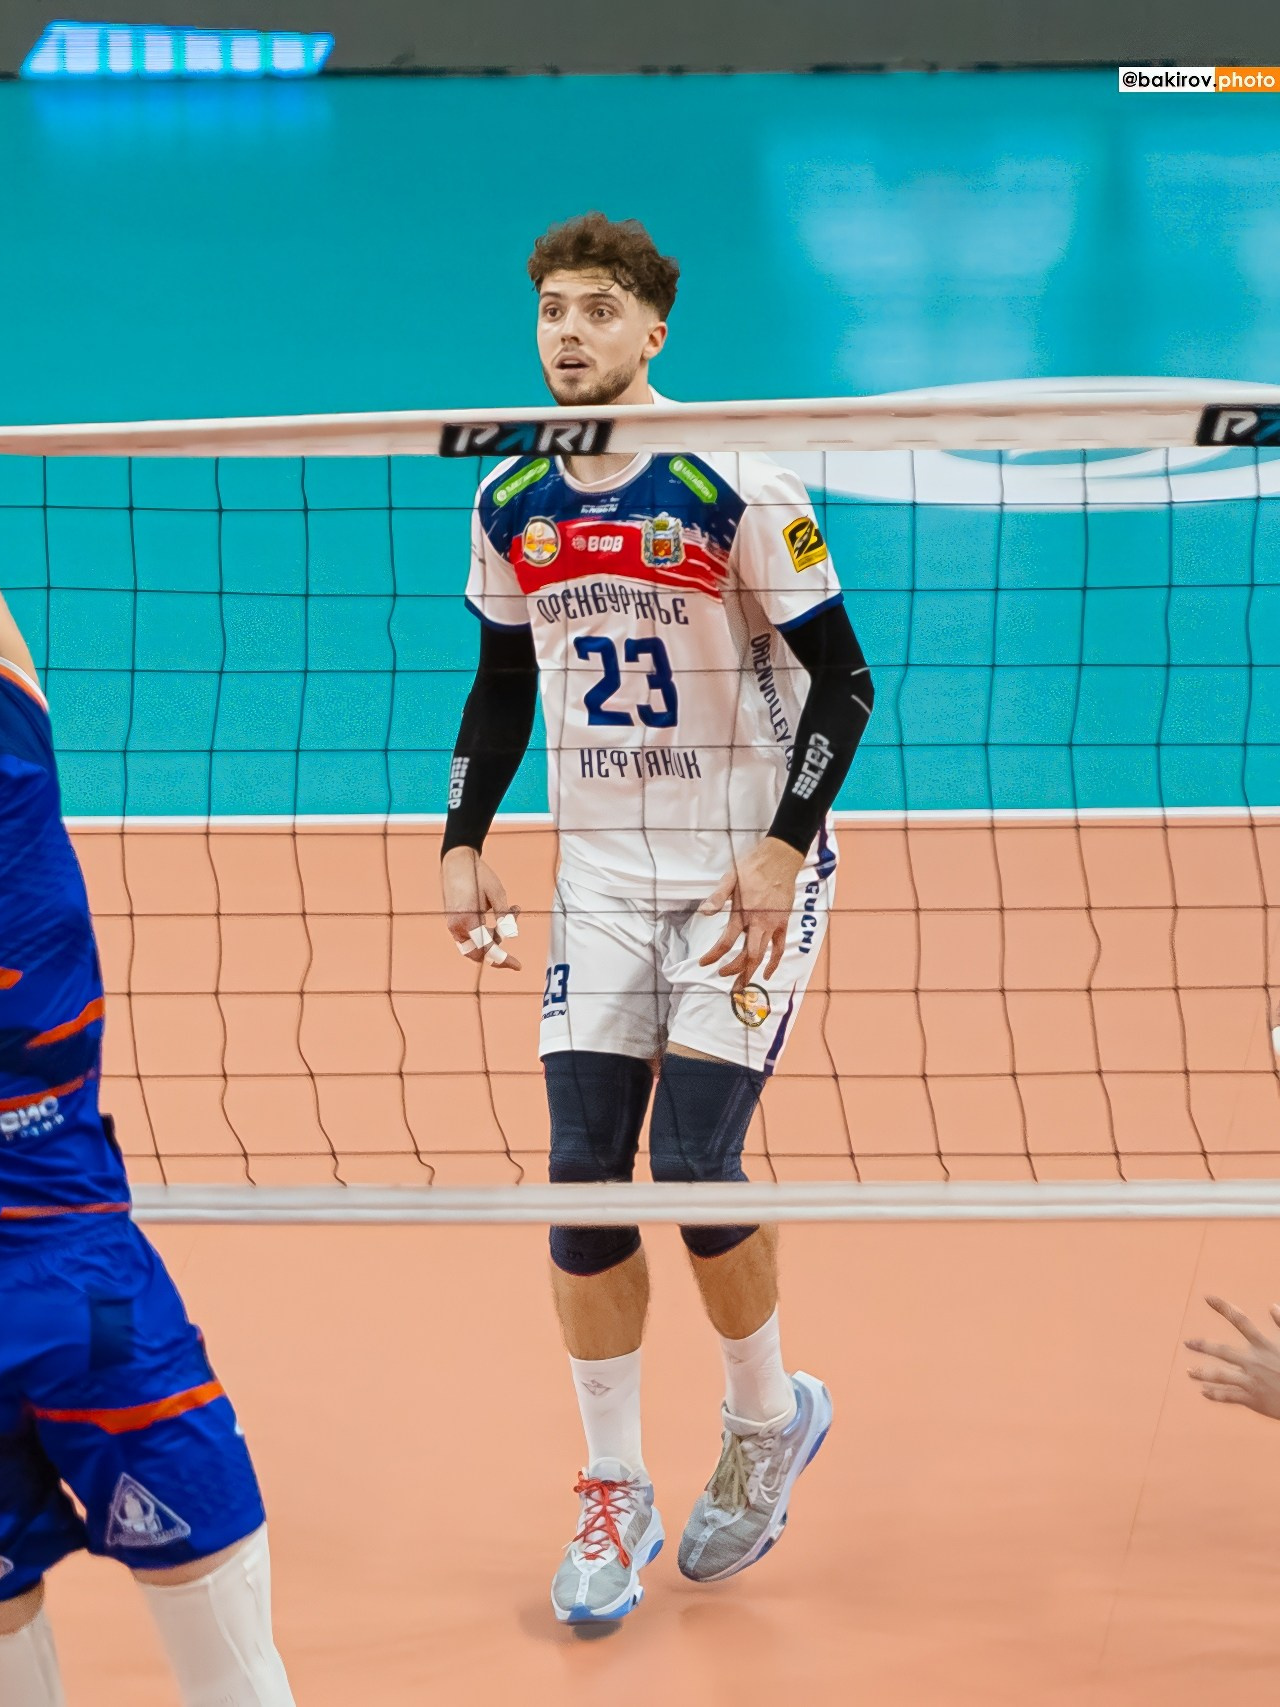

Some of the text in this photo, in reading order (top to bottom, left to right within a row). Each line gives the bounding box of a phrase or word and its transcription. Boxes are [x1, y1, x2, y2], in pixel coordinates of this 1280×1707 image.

[455, 421, 598, 452] PARI
[587, 535, 624, 553] ВФВ
[536, 581, 690, 626] ОРЕНБУРЖЬЕ
[573, 636, 679, 728] 23
[579, 748, 702, 780] НЕФТЯНИК
